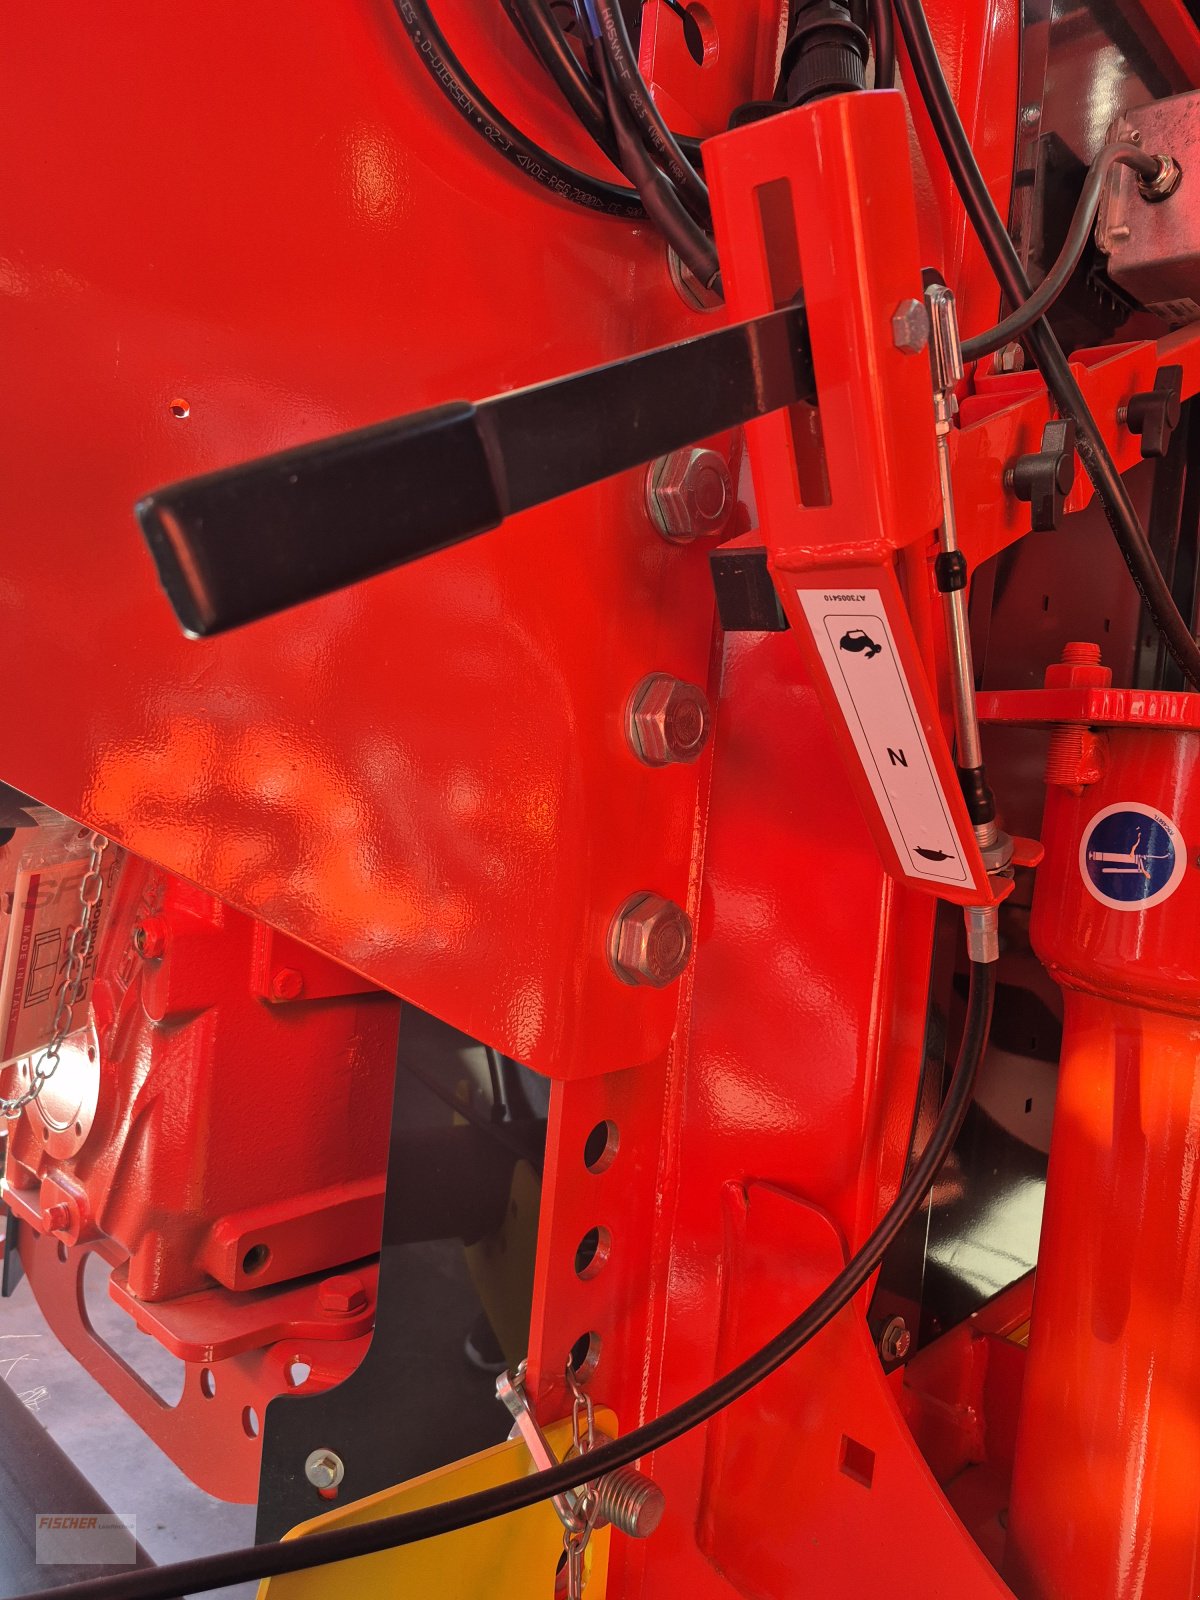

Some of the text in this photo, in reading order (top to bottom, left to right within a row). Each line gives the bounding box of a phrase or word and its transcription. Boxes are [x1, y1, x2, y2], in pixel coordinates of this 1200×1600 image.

[887, 748, 909, 768] N
[8, 924, 31, 1023] MADE IN ITALY
